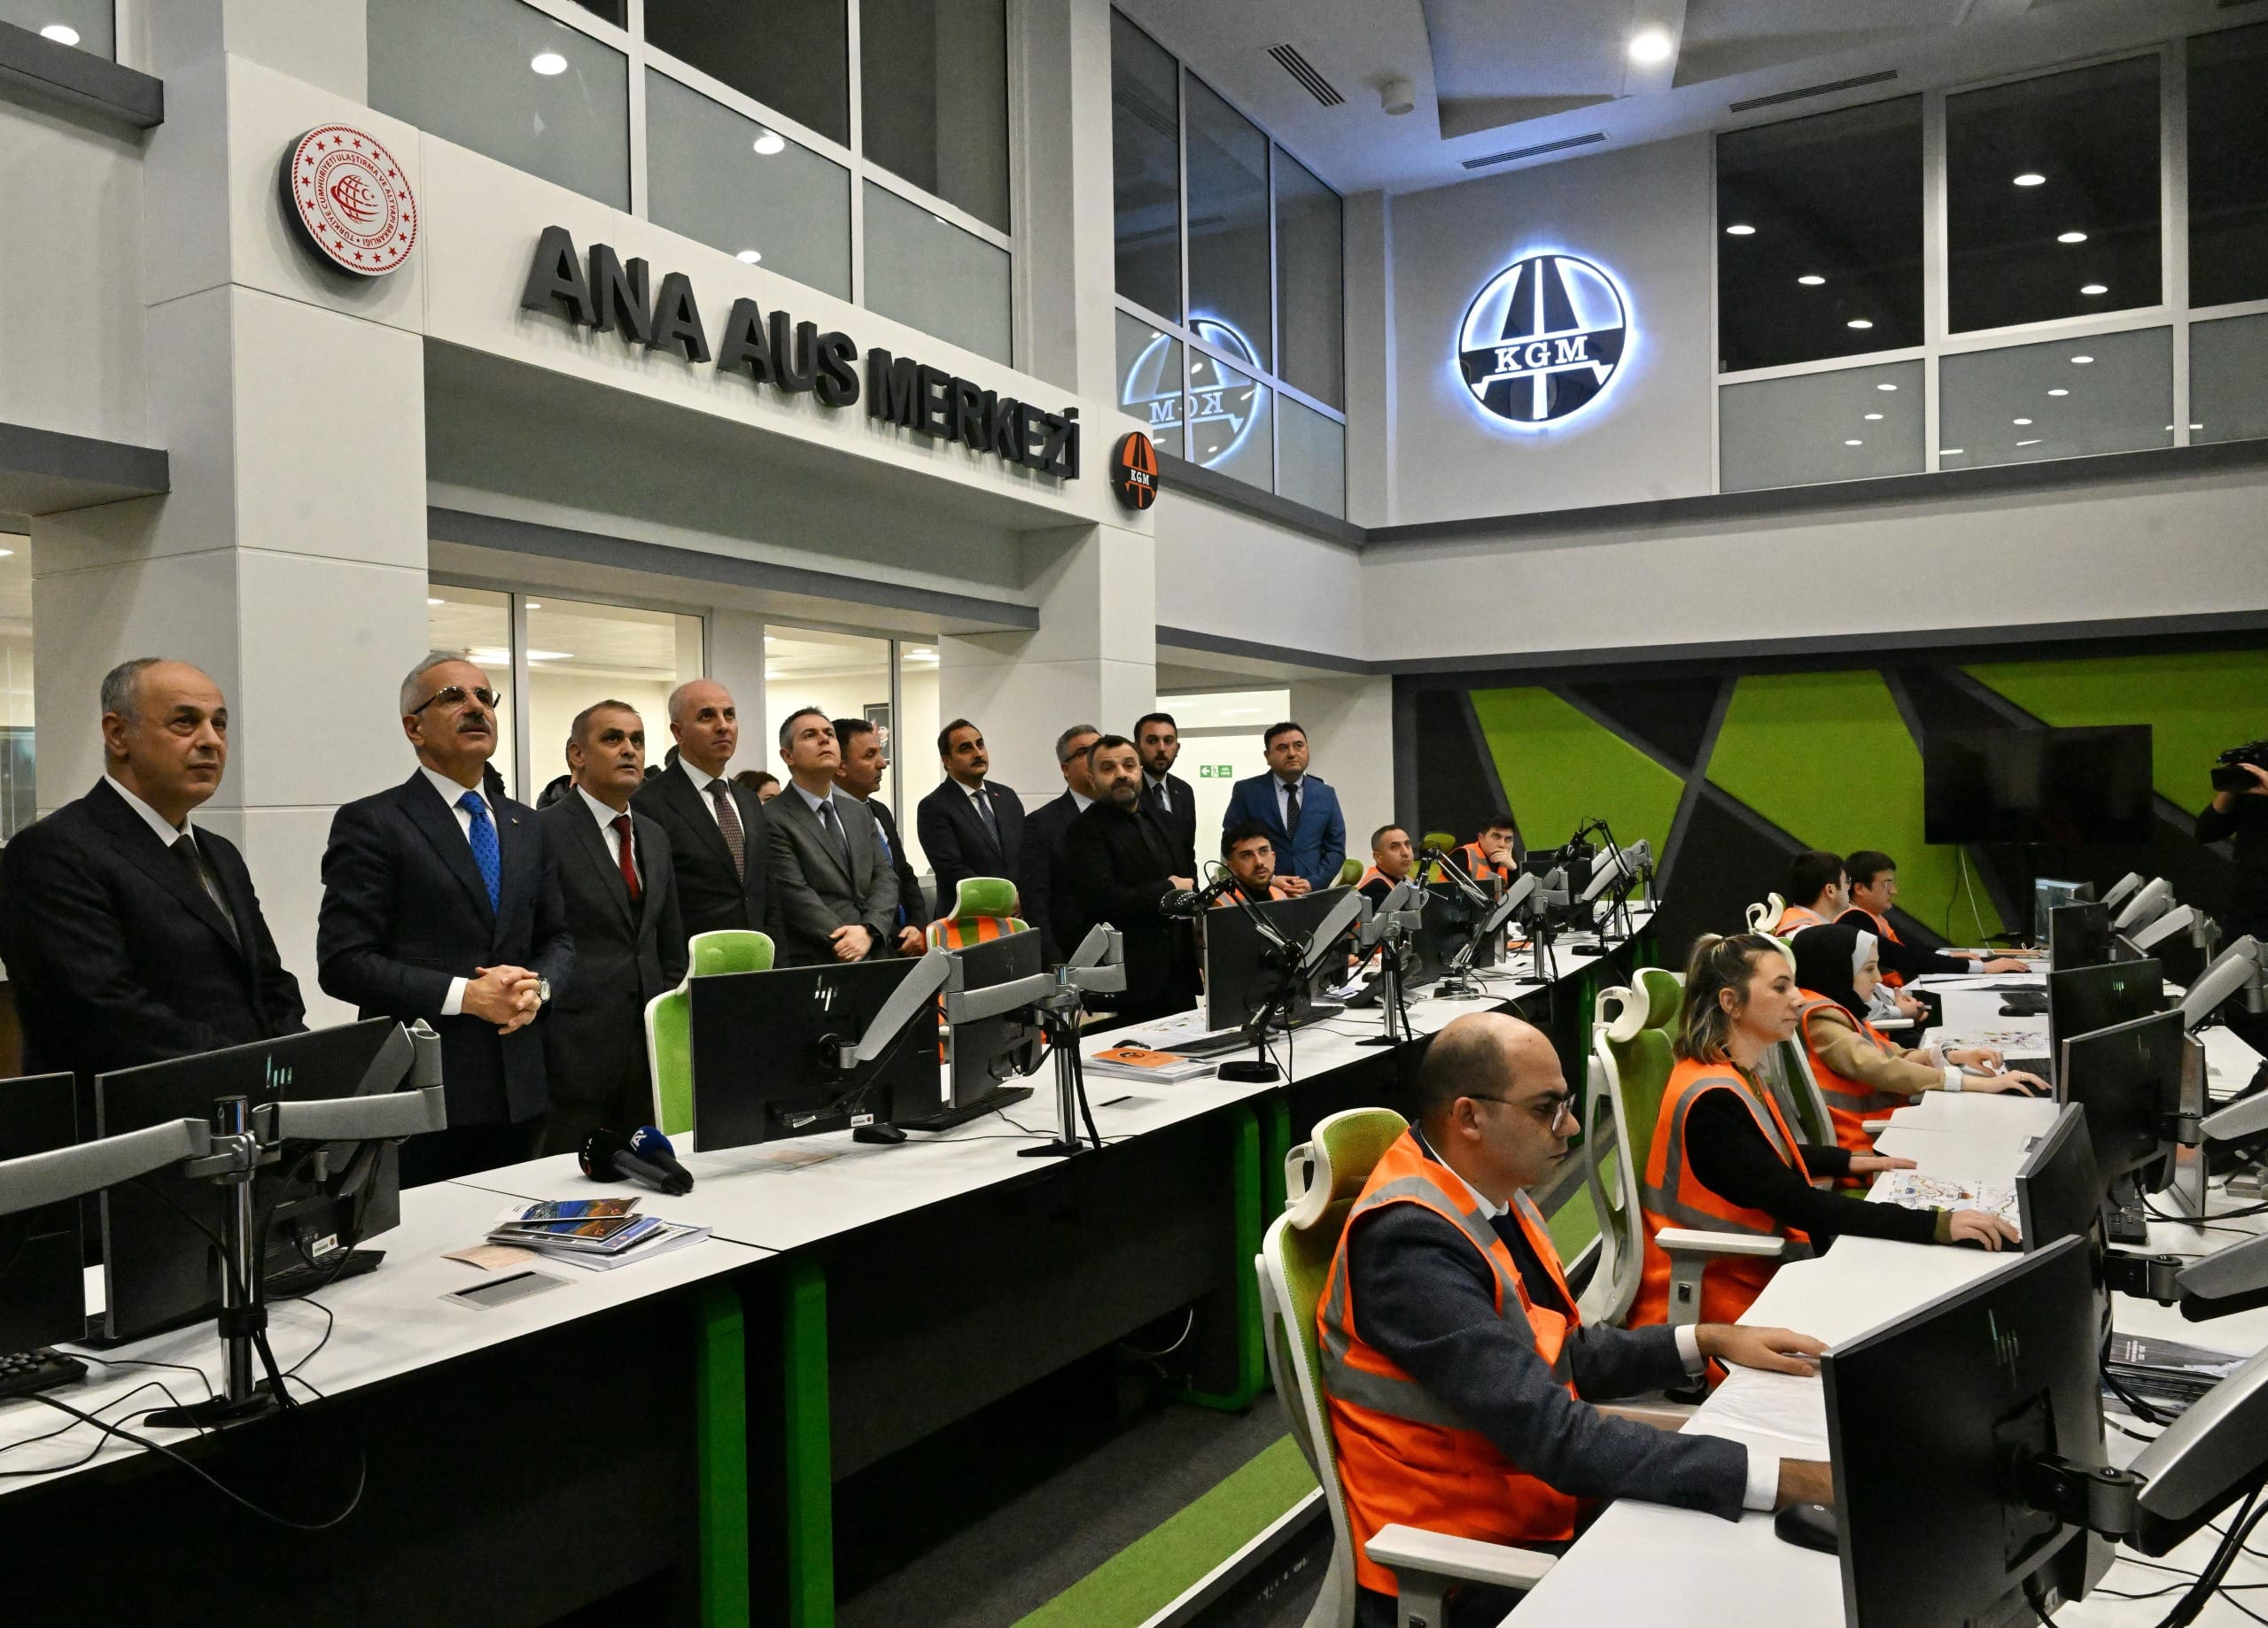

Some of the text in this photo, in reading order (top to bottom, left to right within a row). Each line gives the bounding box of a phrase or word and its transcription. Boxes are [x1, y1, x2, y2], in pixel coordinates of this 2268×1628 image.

[337, 153, 378, 176] ULAŞTIRMA
[318, 154, 338, 209] CUMHURİYETİ
[378, 175, 388, 187] VE
[385, 189, 396, 224] ALTYAPI
[362, 223, 394, 247] BAKANLIĞI
[522, 225, 1080, 480] ANA AUS MERKEZİ
[1495, 336, 1588, 374] KGM
[1130, 469, 1150, 486] KGM
